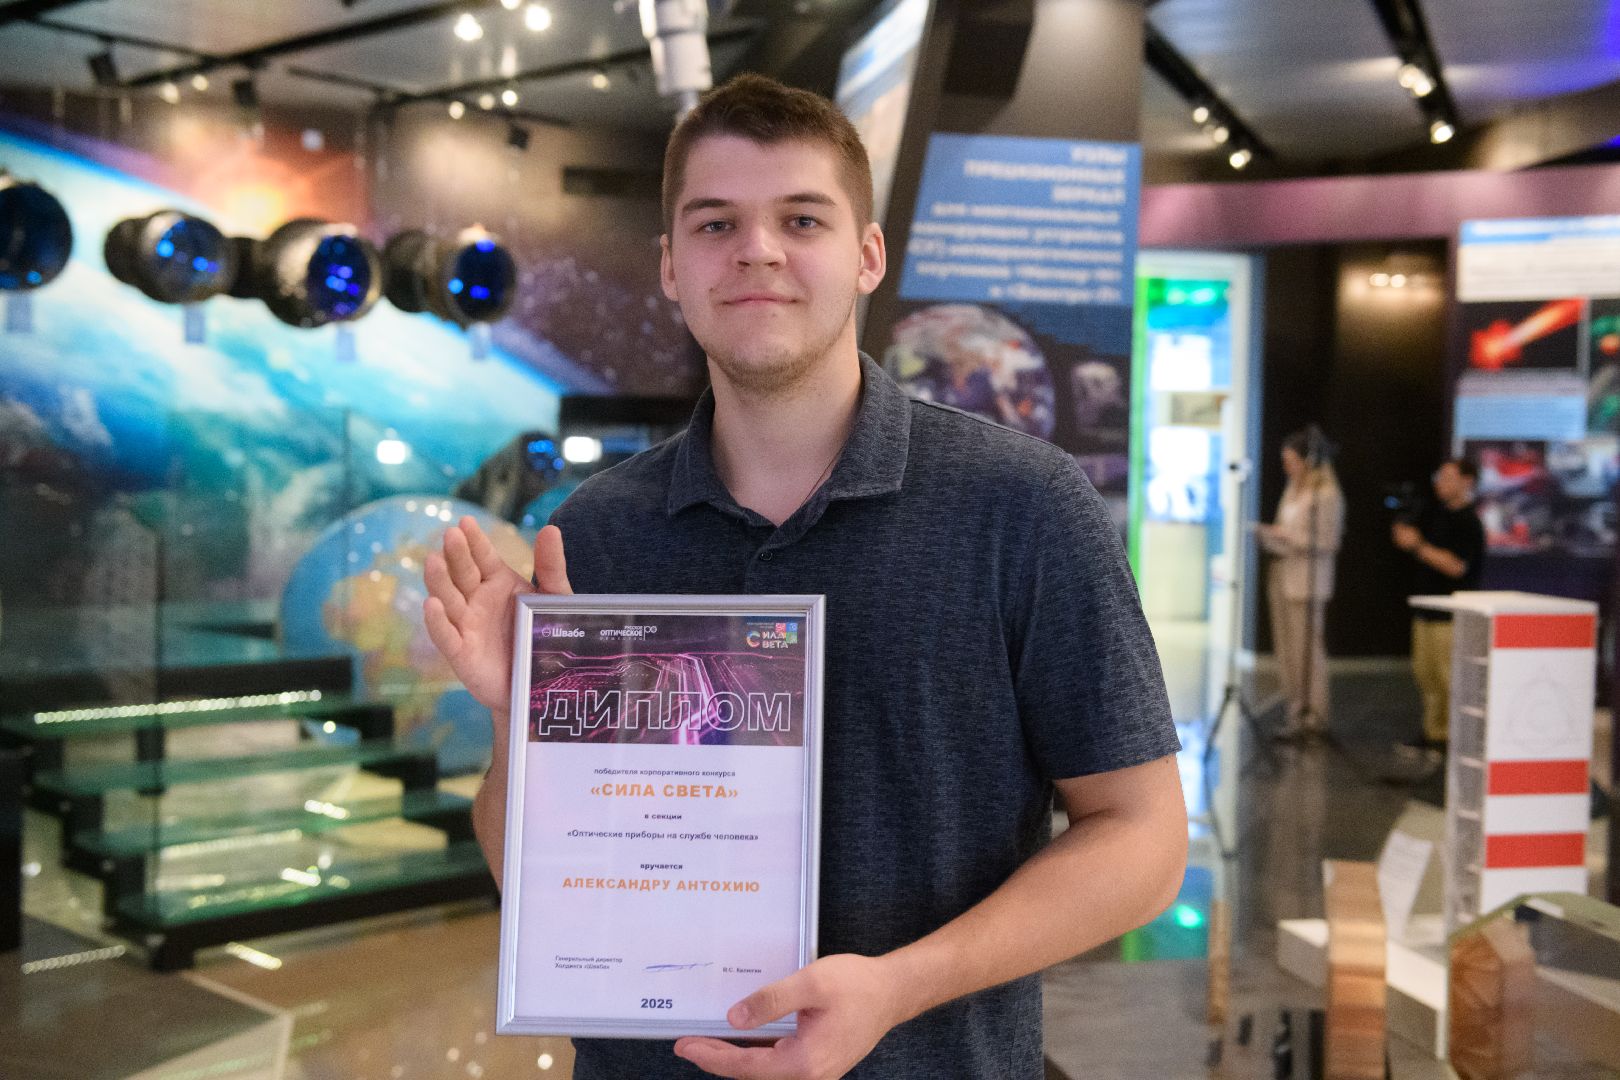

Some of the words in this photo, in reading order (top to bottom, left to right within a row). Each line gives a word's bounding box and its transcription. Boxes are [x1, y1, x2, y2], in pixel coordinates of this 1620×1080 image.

[552, 626, 585, 638] Швабе
[600, 629, 643, 637] ОПТИЧЕСКОЕ
[538, 690, 792, 736] ДИПЛОМ
[594, 768, 638, 776] победителя
[640, 769, 700, 778] корпоративного
[702, 770, 736, 778] конкурса
[590, 783, 656, 797] «СИЛА
[663, 784, 738, 799] СВЕТА»
[567, 830, 624, 838] «Оптические
[625, 831, 665, 841] приборы
[679, 831, 712, 841] службе
[714, 833, 759, 841] человека»
[640, 863, 684, 872] вручается
[562, 878, 670, 892] АЛЕКСАНДРУ
[676, 880, 760, 892] АНТОХИЮ
[640, 998, 673, 1010] 2025
